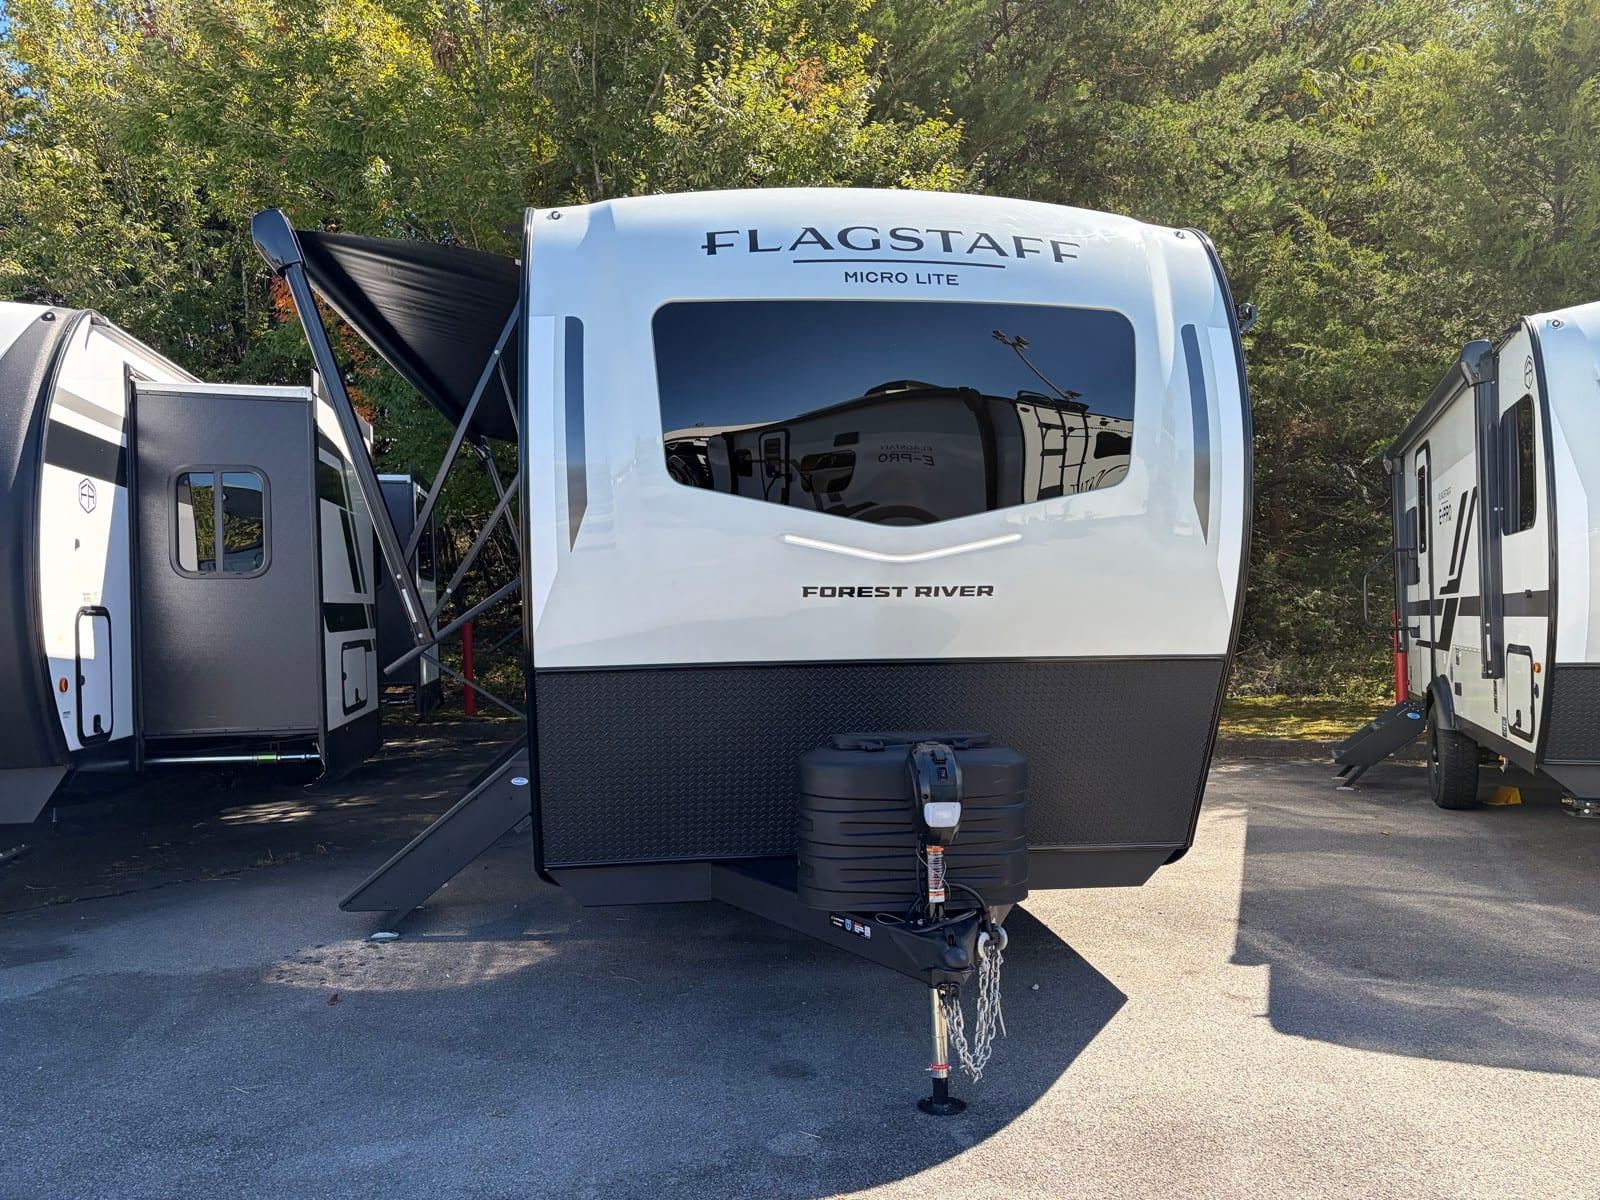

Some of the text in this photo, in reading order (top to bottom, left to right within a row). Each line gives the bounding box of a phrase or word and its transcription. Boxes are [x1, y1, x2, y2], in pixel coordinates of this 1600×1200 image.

[701, 226, 1081, 263] FLAGSTAFF
[844, 271, 959, 286] MICRO LITE
[802, 585, 994, 598] FOREST RIVER
